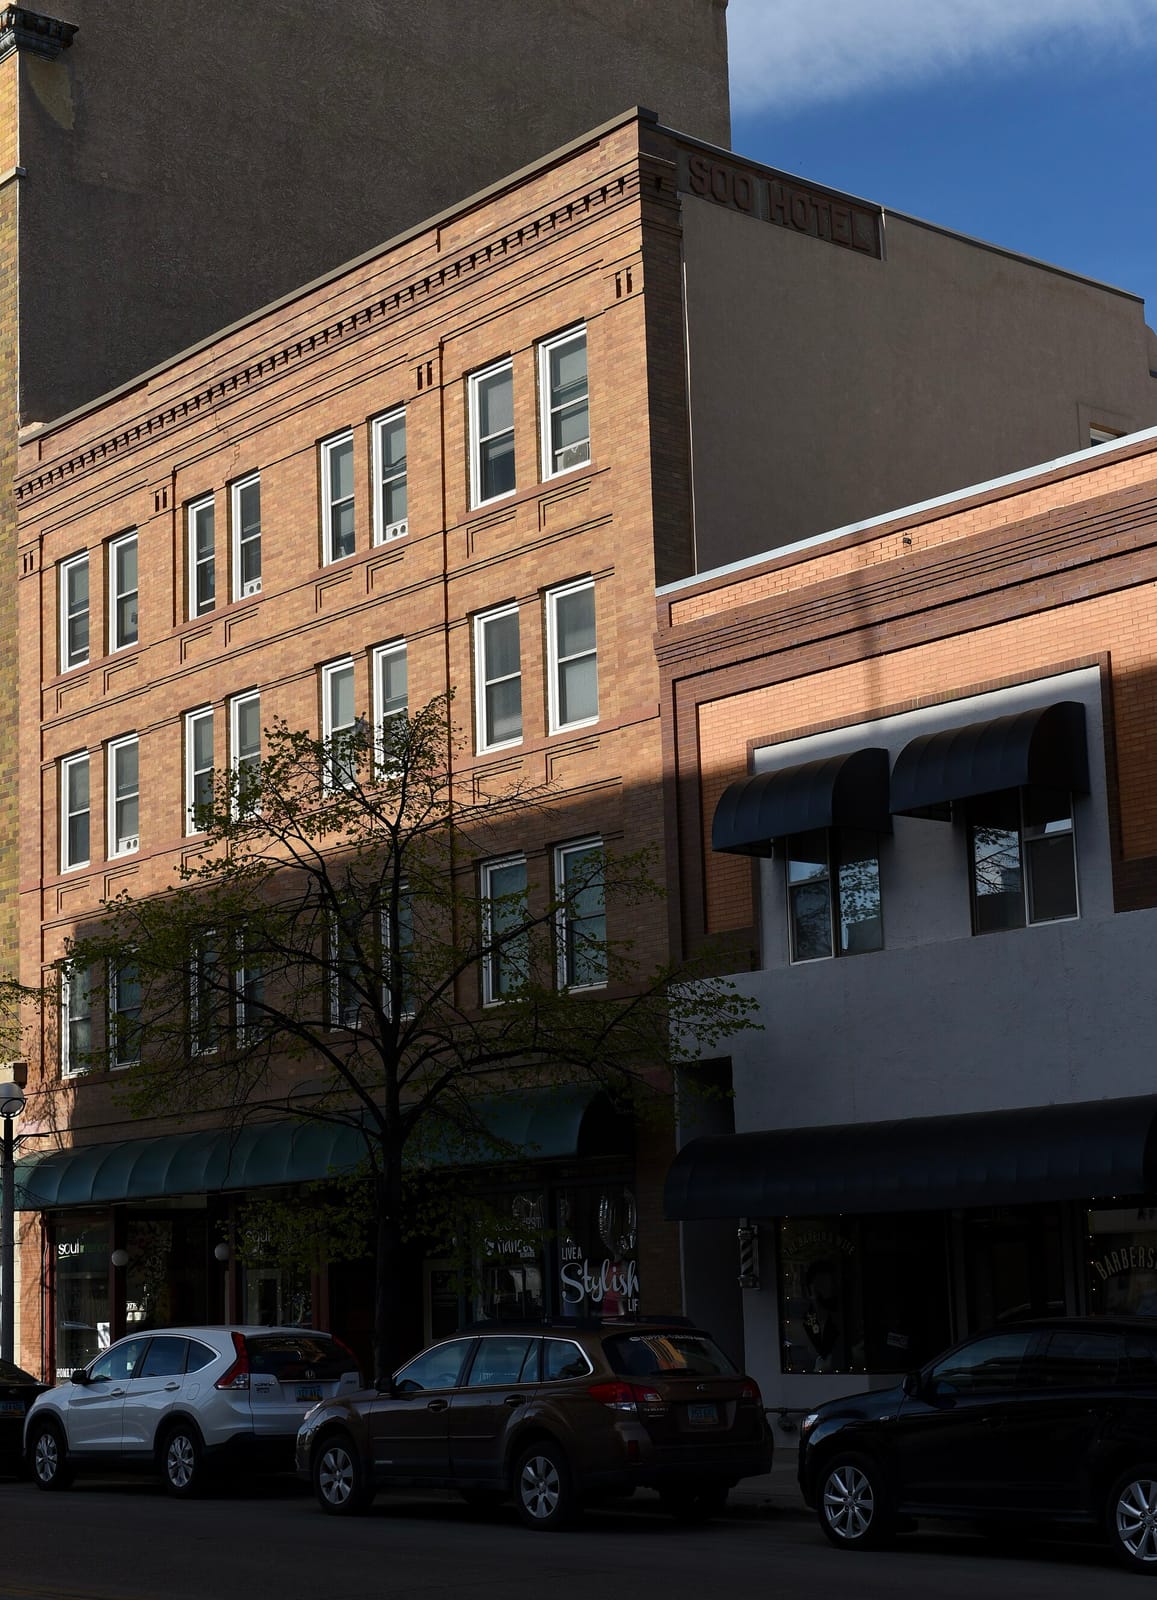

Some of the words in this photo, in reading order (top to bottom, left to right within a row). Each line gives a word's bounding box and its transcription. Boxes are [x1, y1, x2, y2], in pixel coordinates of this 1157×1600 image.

[688, 154, 754, 213] SOO
[767, 181, 872, 252] HOTEL
[58, 1238, 79, 1255] soul
[561, 1247, 576, 1260] LIVE
[560, 1258, 640, 1304] Stylish
[628, 1299, 640, 1312] LIF
